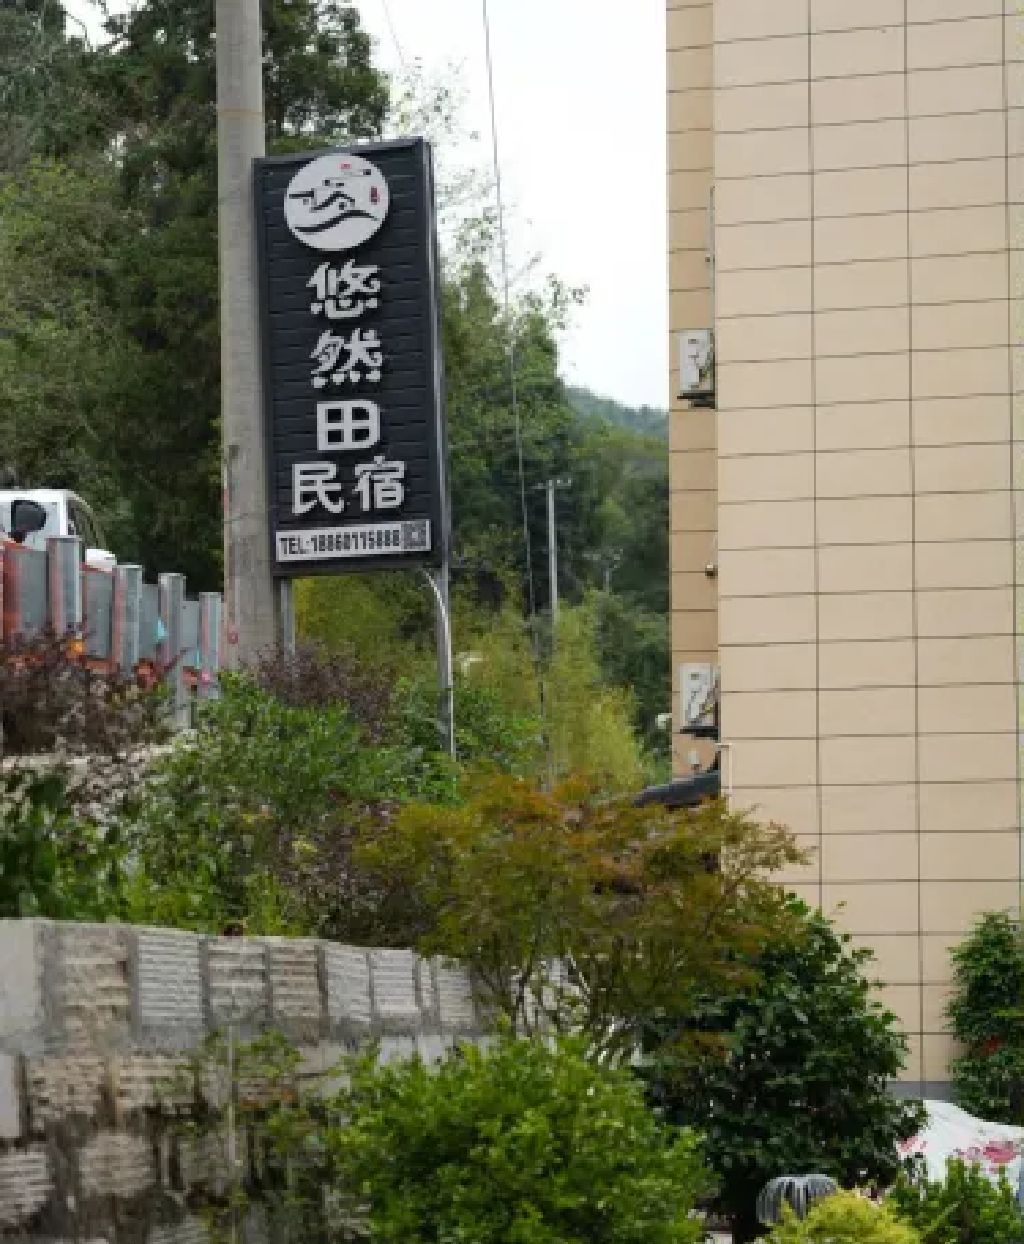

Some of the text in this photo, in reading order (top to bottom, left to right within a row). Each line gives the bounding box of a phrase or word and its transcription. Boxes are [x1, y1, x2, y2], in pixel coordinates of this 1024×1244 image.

[306, 258, 382, 451] 悠然田
[291, 455, 406, 515] 民宿
